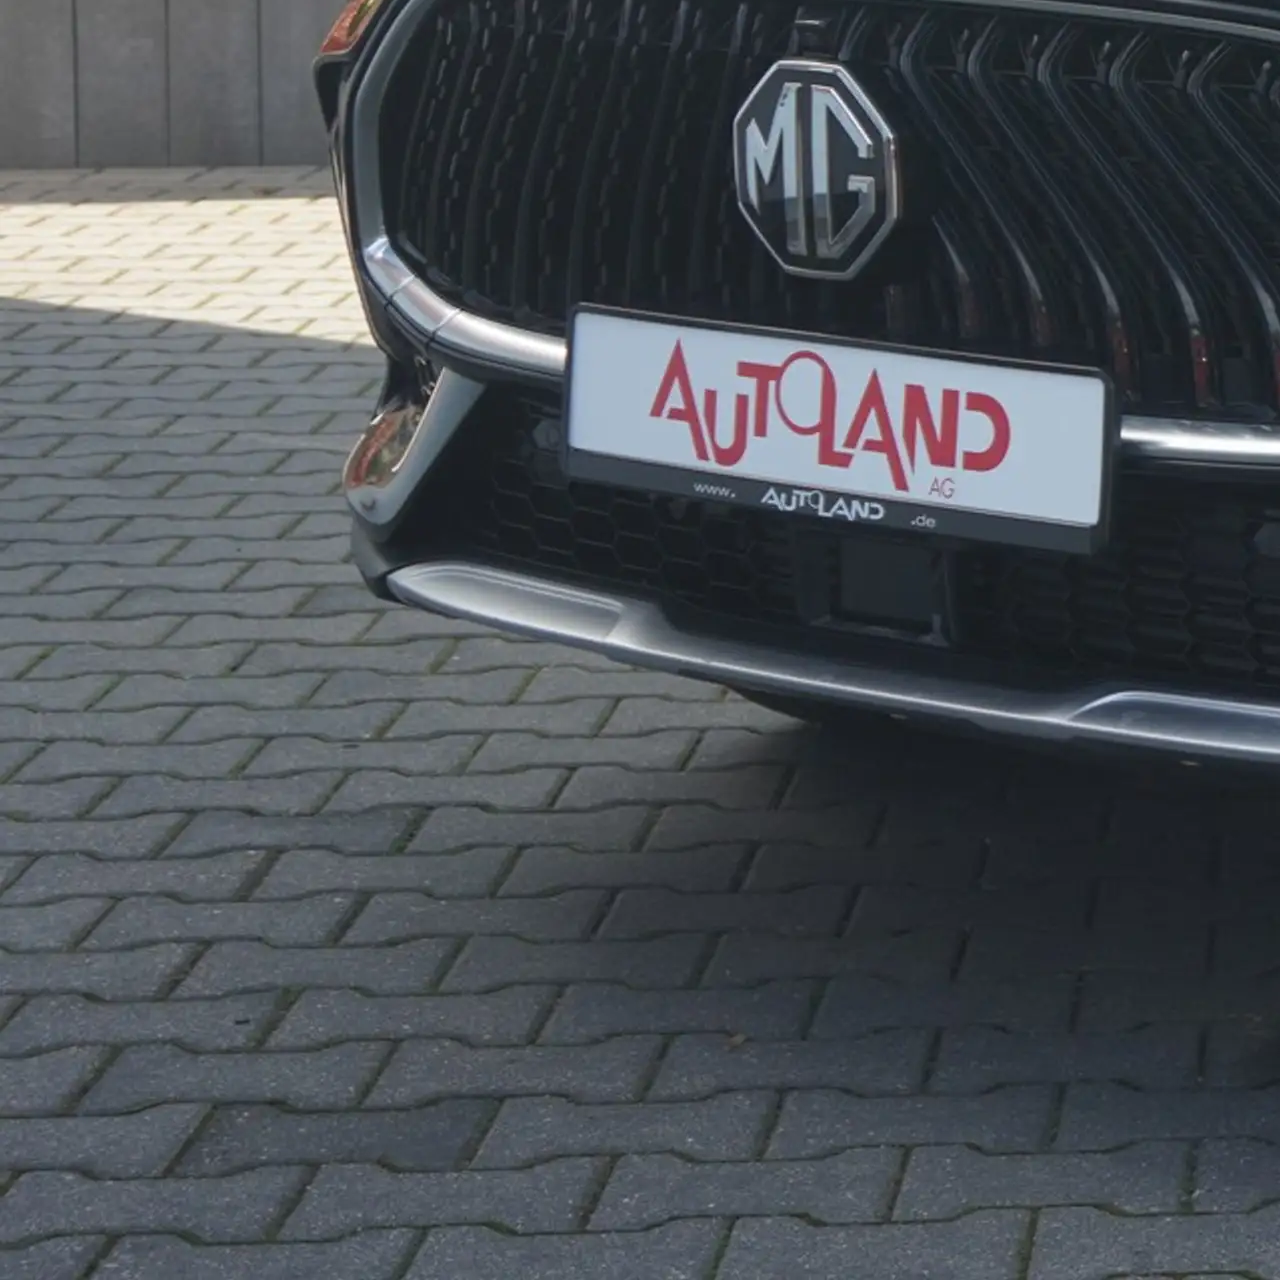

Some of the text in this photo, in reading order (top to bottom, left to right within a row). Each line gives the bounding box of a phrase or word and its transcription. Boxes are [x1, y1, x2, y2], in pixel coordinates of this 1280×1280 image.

[745, 82, 875, 259] MG
[649, 338, 1011, 492] AUTOLAND
[693, 481, 937, 529] www. AUTOLAND .de
[928, 476, 956, 499] AG
